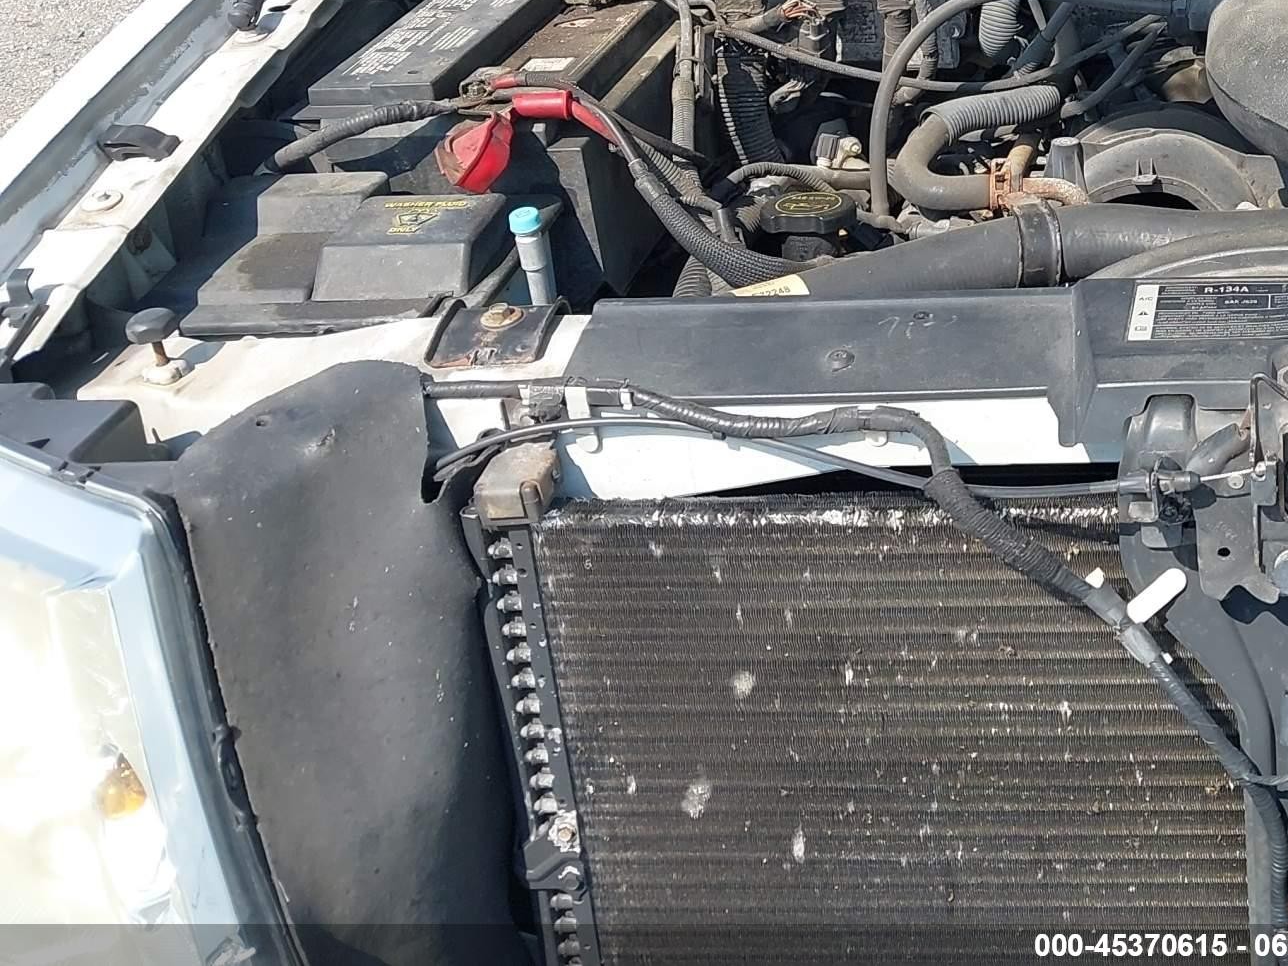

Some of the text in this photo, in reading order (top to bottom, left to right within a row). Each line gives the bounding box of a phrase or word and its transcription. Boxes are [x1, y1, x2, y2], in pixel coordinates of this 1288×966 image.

[384, 199, 468, 209] WASHER FLUID
[386, 226, 418, 234] ONLY
[1204, 285, 1249, 294] R-134A
